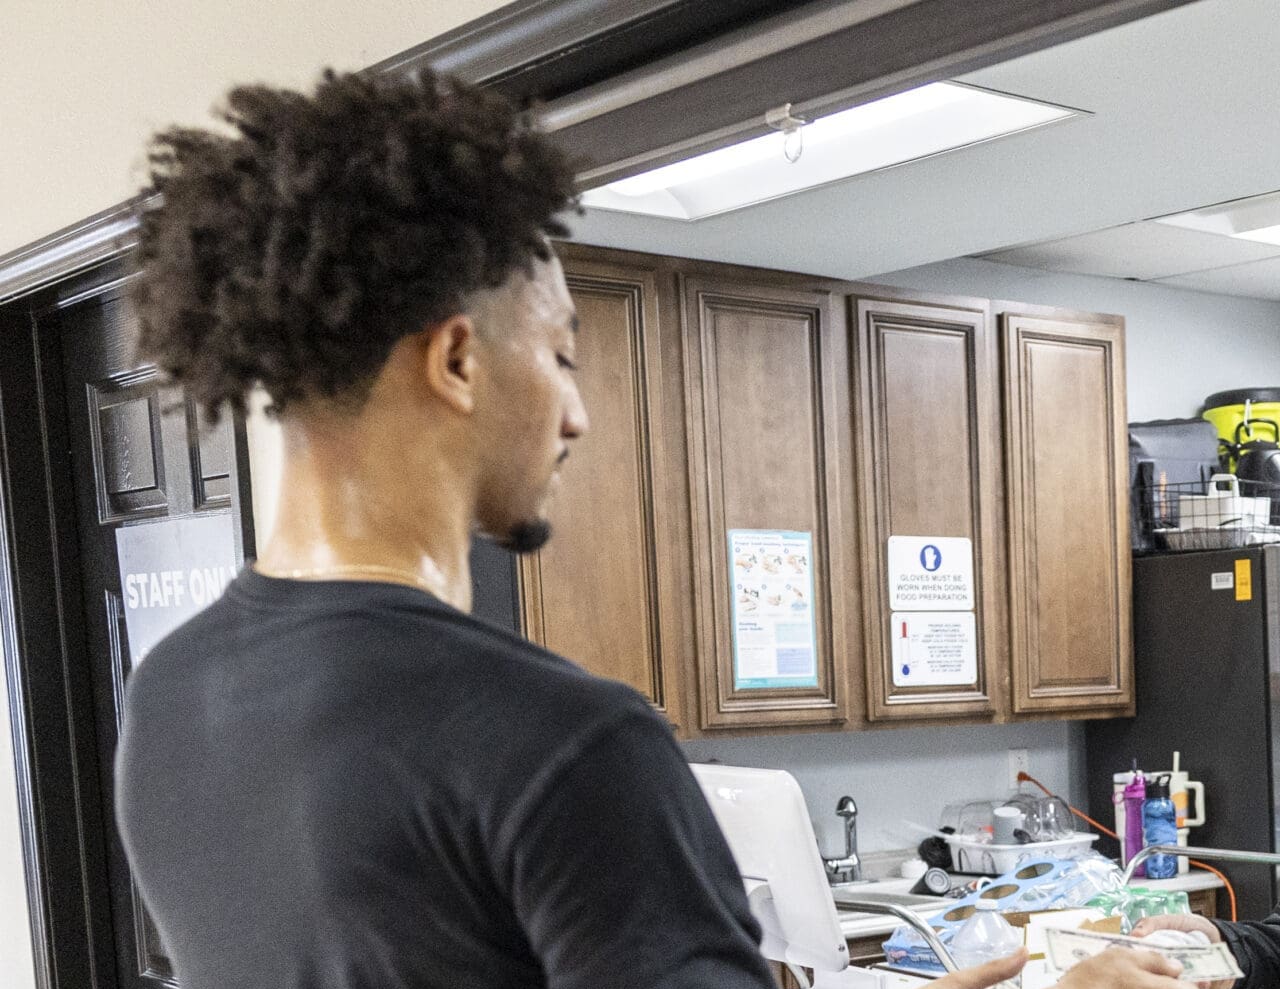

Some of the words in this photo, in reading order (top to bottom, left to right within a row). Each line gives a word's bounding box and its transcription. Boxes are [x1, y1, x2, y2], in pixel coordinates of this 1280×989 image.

[900, 574, 930, 582] GLOVES
[931, 574, 951, 582] MUST
[952, 574, 963, 582] BE
[126, 571, 185, 610] STAFF
[897, 583, 920, 592] WORN
[921, 583, 942, 592] WHEN
[944, 583, 968, 592] DOING
[896, 593, 918, 601] FOOD
[919, 593, 968, 601] PREPARATION
